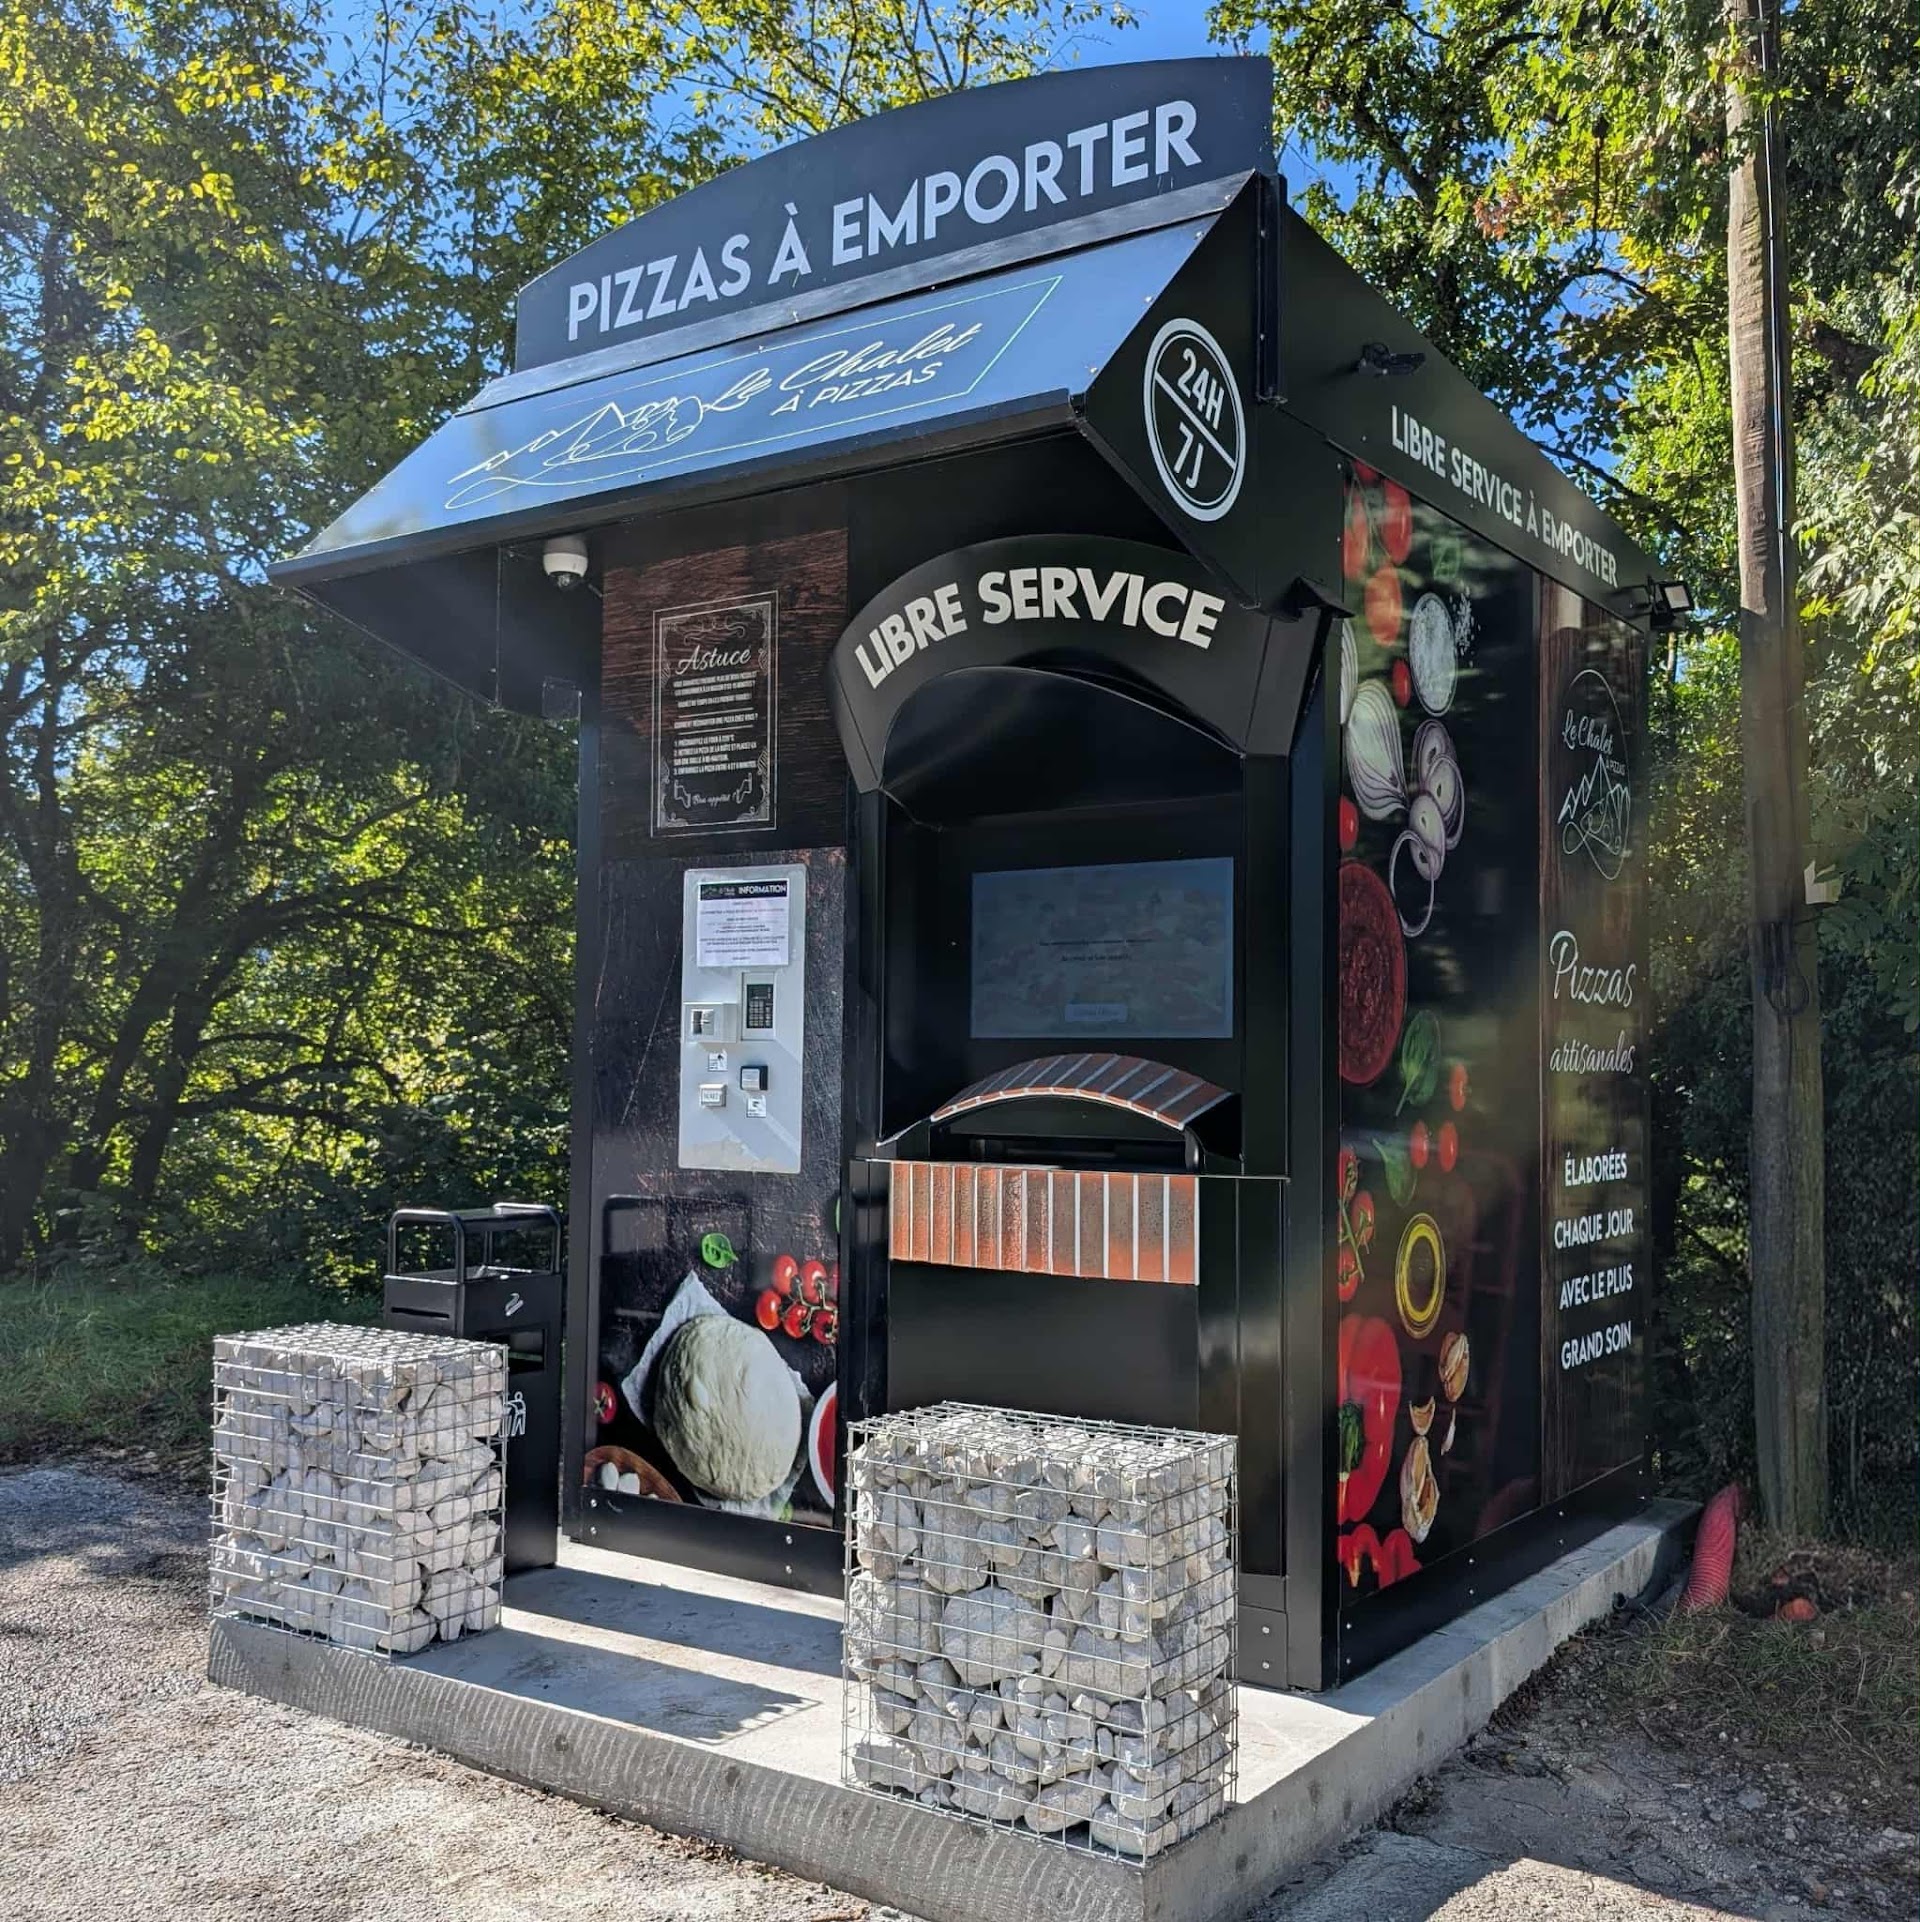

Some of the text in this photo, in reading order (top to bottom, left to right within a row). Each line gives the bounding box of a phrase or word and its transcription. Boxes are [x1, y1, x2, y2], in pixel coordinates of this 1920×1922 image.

[568, 100, 1202, 341] PIZZAS À EMPORTER
[706, 323, 983, 411] Le Chalet
[808, 362, 944, 408] PIZZAS
[1177, 347, 1225, 430] 24H
[1173, 421, 1204, 489] 7J
[1391, 404, 1618, 588] LIBRE SERVICE À EMPORTER
[854, 566, 1226, 689] LIBRE SERVICE
[675, 645, 752, 675] Astuce
[1562, 709, 1614, 755] Le Chalet
[738, 884, 787, 895] INFORMATION
[1550, 930, 1637, 1008] Pizzas
[1550, 1030, 1636, 1074] artisanales
[1564, 1148, 1628, 1187] ÉLABORÉES
[1554, 1208, 1634, 1250] CHAQUE JOUR
[1559, 1263, 1633, 1310] AVEC LE PLUS
[1561, 1320, 1632, 1370] GRAND SOIN
